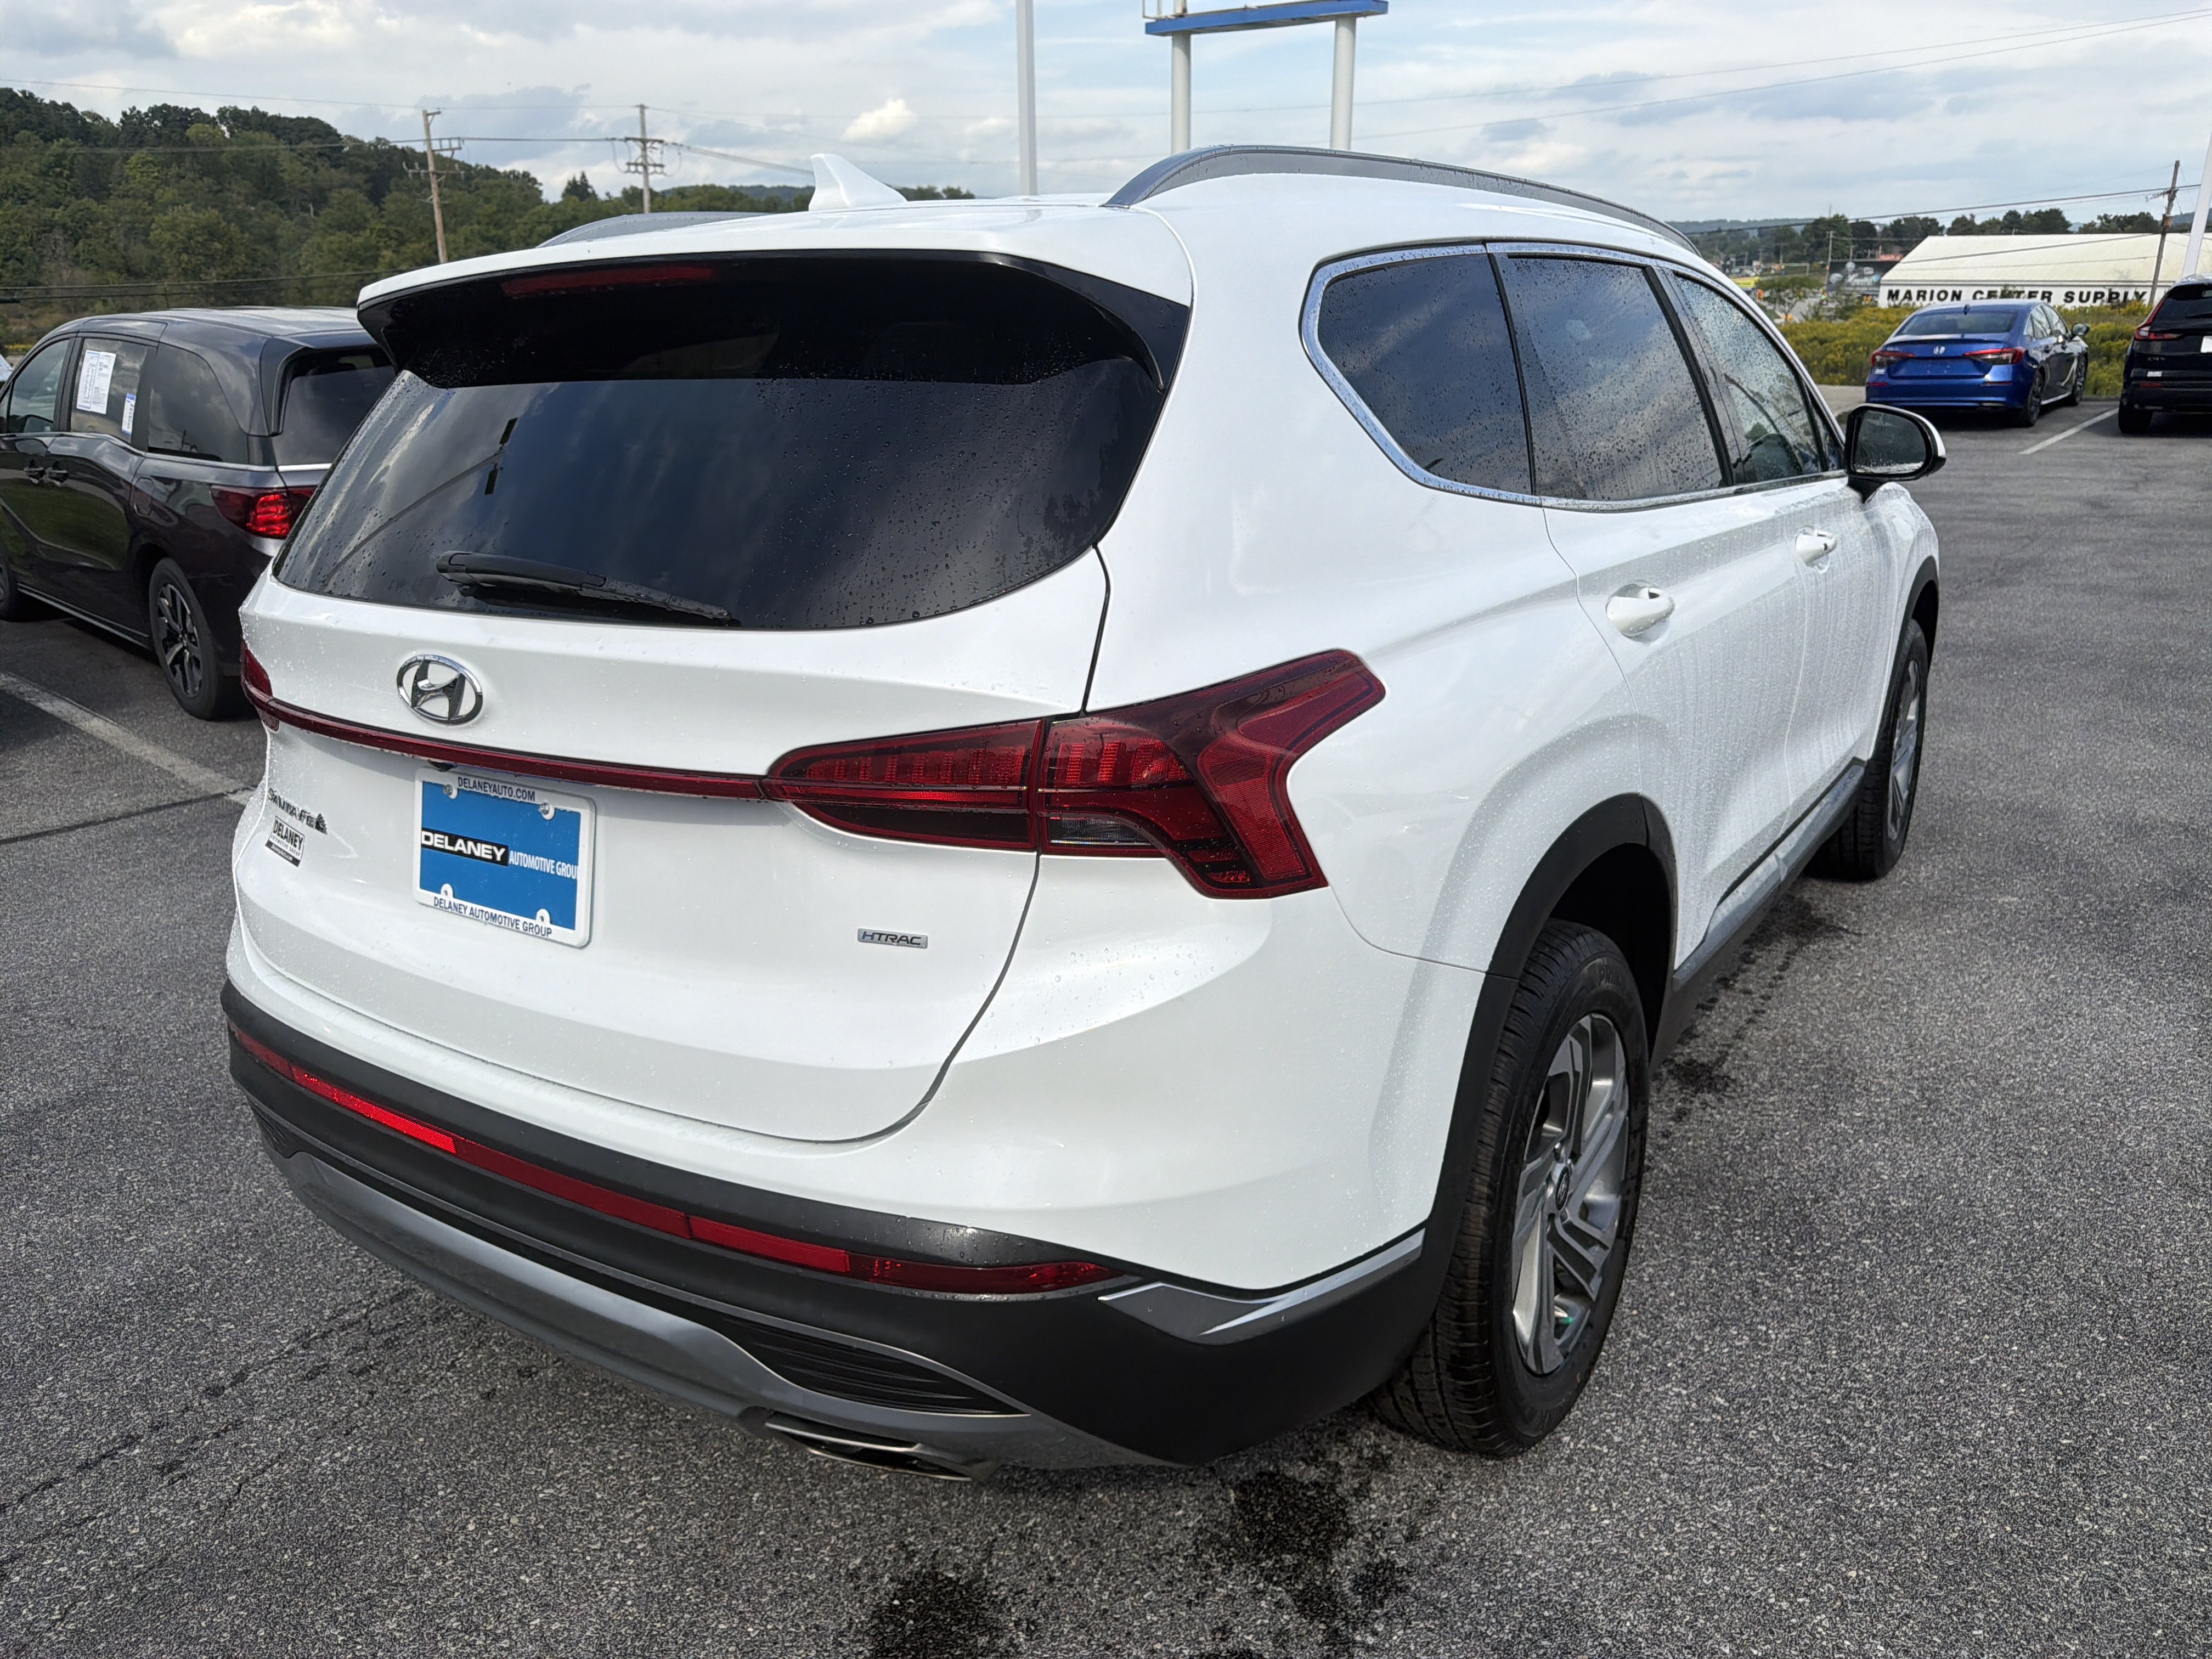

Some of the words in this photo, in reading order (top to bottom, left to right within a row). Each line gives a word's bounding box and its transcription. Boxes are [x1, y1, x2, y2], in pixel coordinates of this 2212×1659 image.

[1887, 289, 1962, 302] MARION
[458, 776, 535, 802] DELANEYAUTO.COM
[268, 788, 300, 821] SANTA
[273, 820, 303, 850] DELANEY
[421, 830, 506, 861] DELANEY
[509, 850, 555, 874] AUTOMOTIVE
[433, 896, 468, 915] DELANEY
[469, 906, 521, 929] AUTOMOTIVE
[522, 921, 552, 938] GROUP
[861, 931, 922, 945] HTRAC
